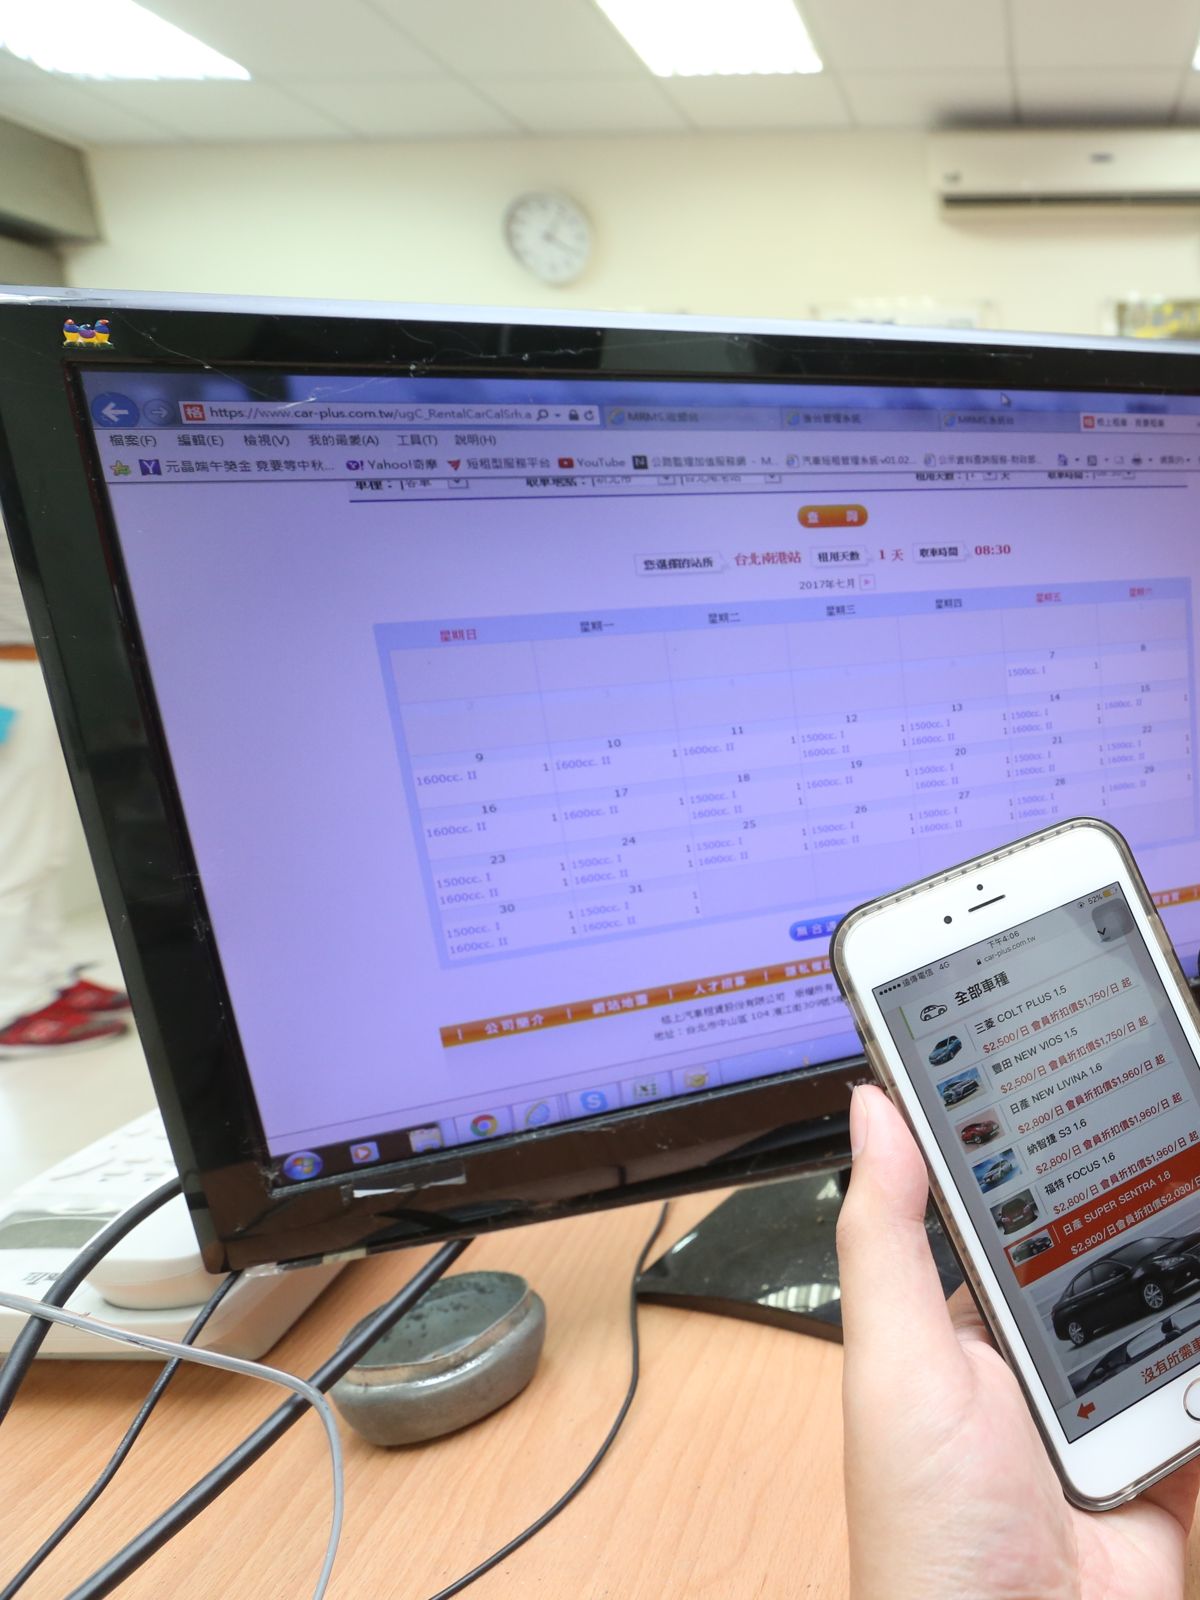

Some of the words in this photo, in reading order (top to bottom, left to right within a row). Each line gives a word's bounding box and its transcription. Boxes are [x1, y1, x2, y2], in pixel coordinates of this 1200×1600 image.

[109, 434, 157, 447] 檔案(F)
[177, 434, 224, 447] 編輯(E)
[244, 434, 290, 447] 檢視(V)
[308, 434, 379, 447] 我的最愛(A)
[397, 434, 438, 447] 工具(T)
[455, 434, 497, 447] 說明(H)
[577, 456, 626, 468] YouTube
[879, 549, 886, 560] 1
[891, 548, 904, 561] 天
[974, 544, 1011, 556] 08:30
[734, 550, 802, 567] 台北南港站
[799, 577, 855, 591] 2017年七月
[935, 598, 963, 610] 星期四
[1035, 591, 1062, 604] 星期五
[826, 604, 856, 616] 星期三
[708, 612, 741, 624] 星期二
[579, 620, 615, 633] 星期一
[439, 628, 477, 642] 星期日
[1050, 693, 1060, 701] 14
[951, 703, 963, 712] 13
[845, 714, 858, 724] 12
[731, 726, 744, 735] 11
[607, 738, 622, 749] 10
[1052, 736, 1062, 744] 21
[475, 753, 484, 762] 9
[954, 747, 967, 756] 20
[850, 759, 863, 769] 19
[737, 773, 751, 783] 18
[614, 787, 629, 798] 17
[958, 790, 971, 800] 27
[481, 803, 497, 815] 16
[743, 820, 757, 830] 25
[621, 836, 636, 847] 24
[489, 854, 506, 865] 23
[628, 884, 643, 894] 31
[1087, 893, 1102, 905] 52%
[499, 903, 516, 914] 30
[986, 929, 1019, 949] 下午4:06
[983, 934, 1036, 963] car-plus.com.tw
[938, 960, 950, 971] 4G
[953, 970, 1010, 1006] 全部車種
[591, 994, 649, 1015] 網站地圖
[973, 1016, 996, 1035] 三菱
[996, 1004, 1023, 1023] COLT
[1024, 991, 1052, 1010] PLUS
[1053, 983, 1067, 997] 1.5
[982, 1024, 1030, 1054] $2,500/日
[1030, 982, 1119, 1031] 會員折扣價$1,750/日
[1120, 976, 1132, 989] 起
[484, 1013, 545, 1035] 公司簡介
[991, 1057, 1013, 1075] 豐田
[1013, 1045, 1038, 1063] NEW
[1039, 1034, 1063, 1051] VIOS
[1063, 1026, 1078, 1039] 1.5
[999, 1064, 1047, 1094] $2,500/日
[1047, 1021, 1137, 1071] 會員折扣價$1,750/日
[1136, 1015, 1149, 1028] 起
[1009, 1097, 1030, 1114] 日產
[1031, 1085, 1055, 1103] NEW
[1056, 1069, 1088, 1091] LIVINA
[1088, 1062, 1103, 1075] 1.6
[1016, 1104, 1065, 1135] $2,800/日
[1065, 1059, 1153, 1111] 會員折扣價$1,960/日
[1153, 1053, 1166, 1066] 起
[1026, 1132, 1057, 1155] 納智捷
[1057, 1125, 1072, 1139] S3
[1072, 1118, 1087, 1131] 1.6
[1034, 1144, 1082, 1174] $2,800/日
[1082, 1098, 1171, 1150] 會員折扣價$1,960/日
[1170, 1091, 1183, 1104] 起
[1043, 1177, 1066, 1195] 福特
[1065, 1159, 1101, 1183] FOCUS
[1101, 1151, 1116, 1165] 1.6
[1051, 1183, 1099, 1215] $2,800/日
[1098, 1137, 1188, 1190] 會員折扣價$1,960/日
[1187, 1130, 1199, 1143] 起
[1062, 1217, 1083, 1235] 日產
[1083, 1199, 1117, 1223] SUPER
[1117, 1178, 1156, 1205] SENTRA
[1156, 1170, 1171, 1183] 1.8
